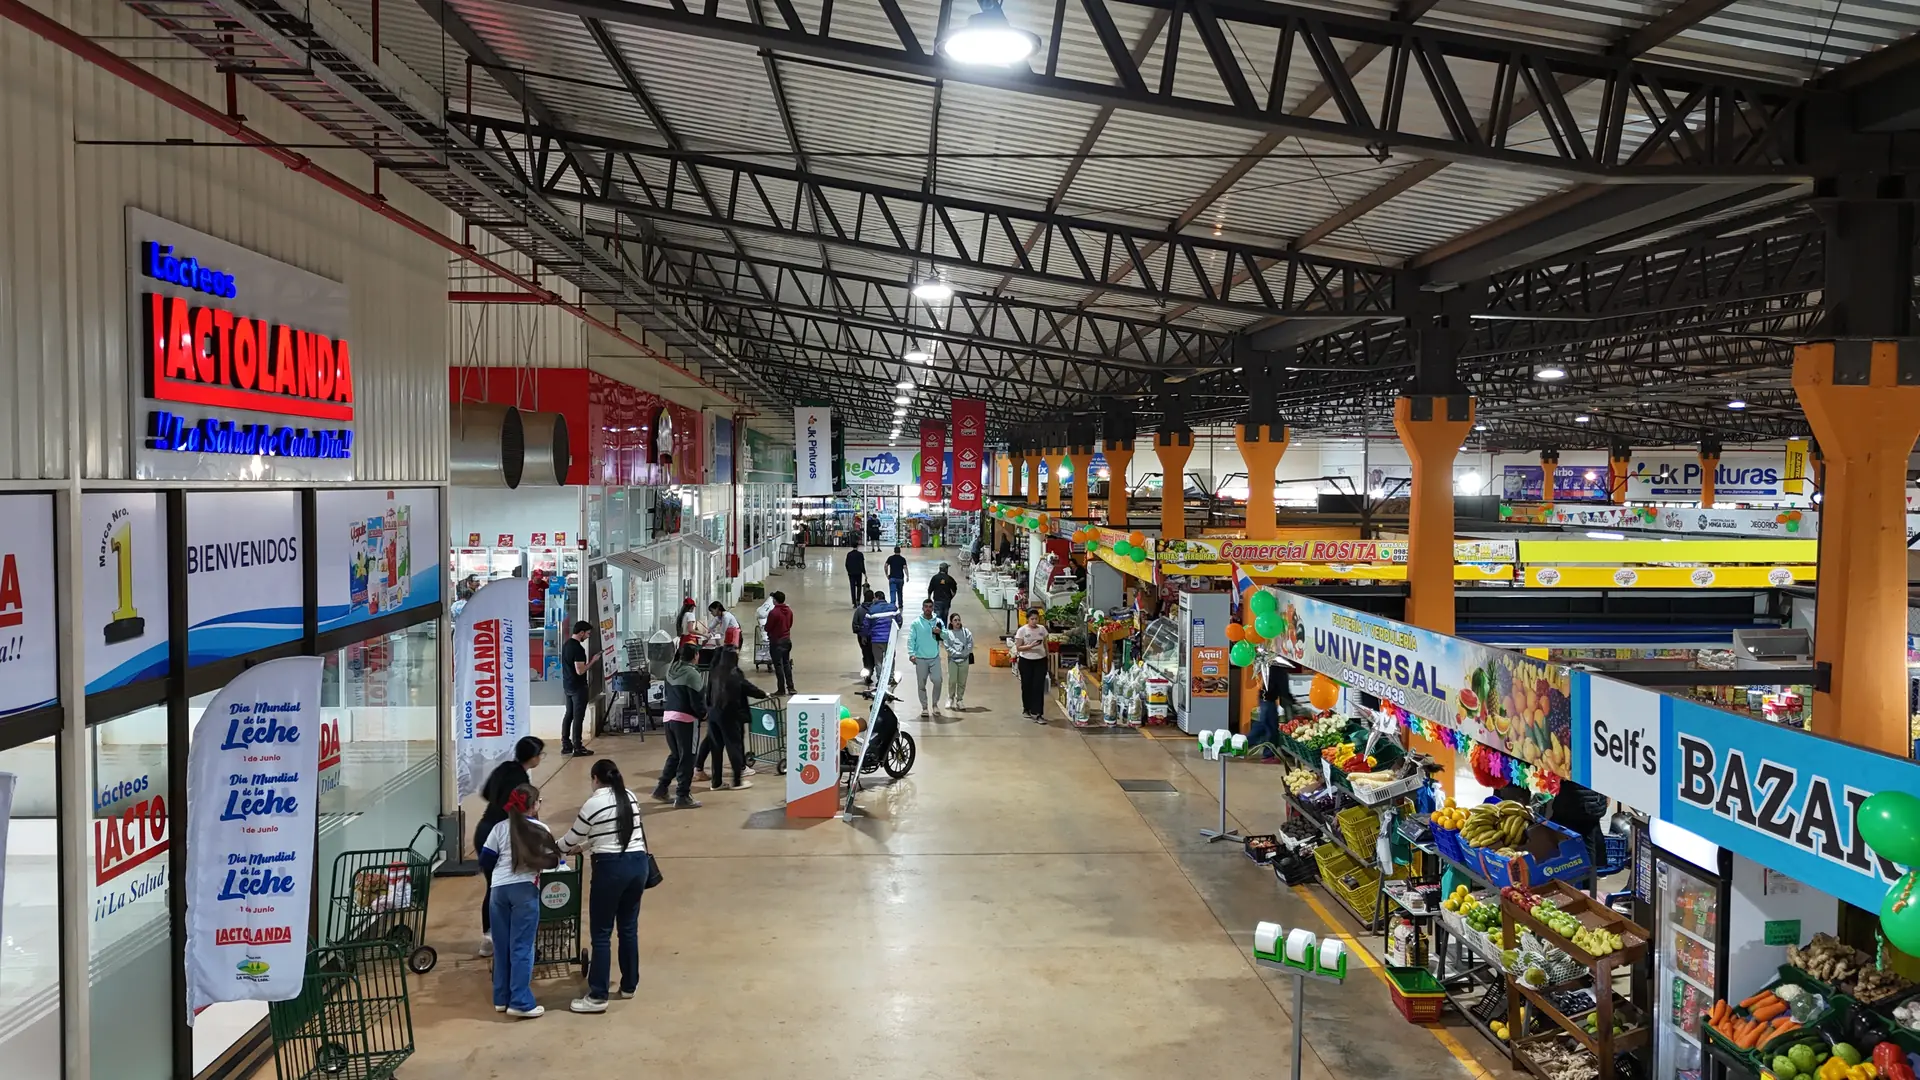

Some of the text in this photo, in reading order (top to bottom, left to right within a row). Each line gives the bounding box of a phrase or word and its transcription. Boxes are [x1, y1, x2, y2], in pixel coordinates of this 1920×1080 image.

[144, 241, 236, 298] Lácteos
[149, 292, 353, 418] LACTOLANDA
[203, 418, 259, 455] Salud
[259, 425, 278, 456] de
[279, 427, 315, 457] Cada
[808, 439, 817, 480] Pinturas
[865, 459, 894, 473] Mix
[1684, 463, 1777, 485] Pturas
[99, 507, 130, 567] Marca Nro.
[1220, 540, 1378, 560] Comercial ROSITA
[187, 536, 297, 574] BIENVENIDOS
[503, 618, 513, 644] Día!!
[1331, 612, 1418, 652] FRUTERÍA Y VERDULERÍA
[503, 647, 514, 670] Cada
[1197, 650, 1222, 660] Aquí!
[1313, 627, 1447, 701] UNIVERSAL
[473, 618, 502, 738] LACTOLANDA
[504, 672, 514, 683] de
[1343, 669, 1405, 705] 0975 847438
[229, 702, 301, 715] Día Mundial
[504, 685, 515, 712] Salud
[220, 718, 300, 750] Leche
[243, 716, 266, 724] de la
[463, 701, 473, 740] Lácteos
[799, 711, 808, 761] ABASTO
[259, 754, 281, 762] Junio
[809, 728, 820, 761] este
[1593, 719, 1656, 776] Self's
[93, 774, 149, 811] Lácteos
[229, 772, 299, 786] Día Mundial
[242, 787, 264, 796] de la
[220, 789, 298, 821] Leche
[227, 851, 296, 865] Día Mundial
[251, 867, 261, 876] la
[129, 864, 165, 903] Salud
[217, 869, 295, 901] Leche
[252, 905, 275, 914] Junio
[215, 926, 292, 946] LACTOLANDA
